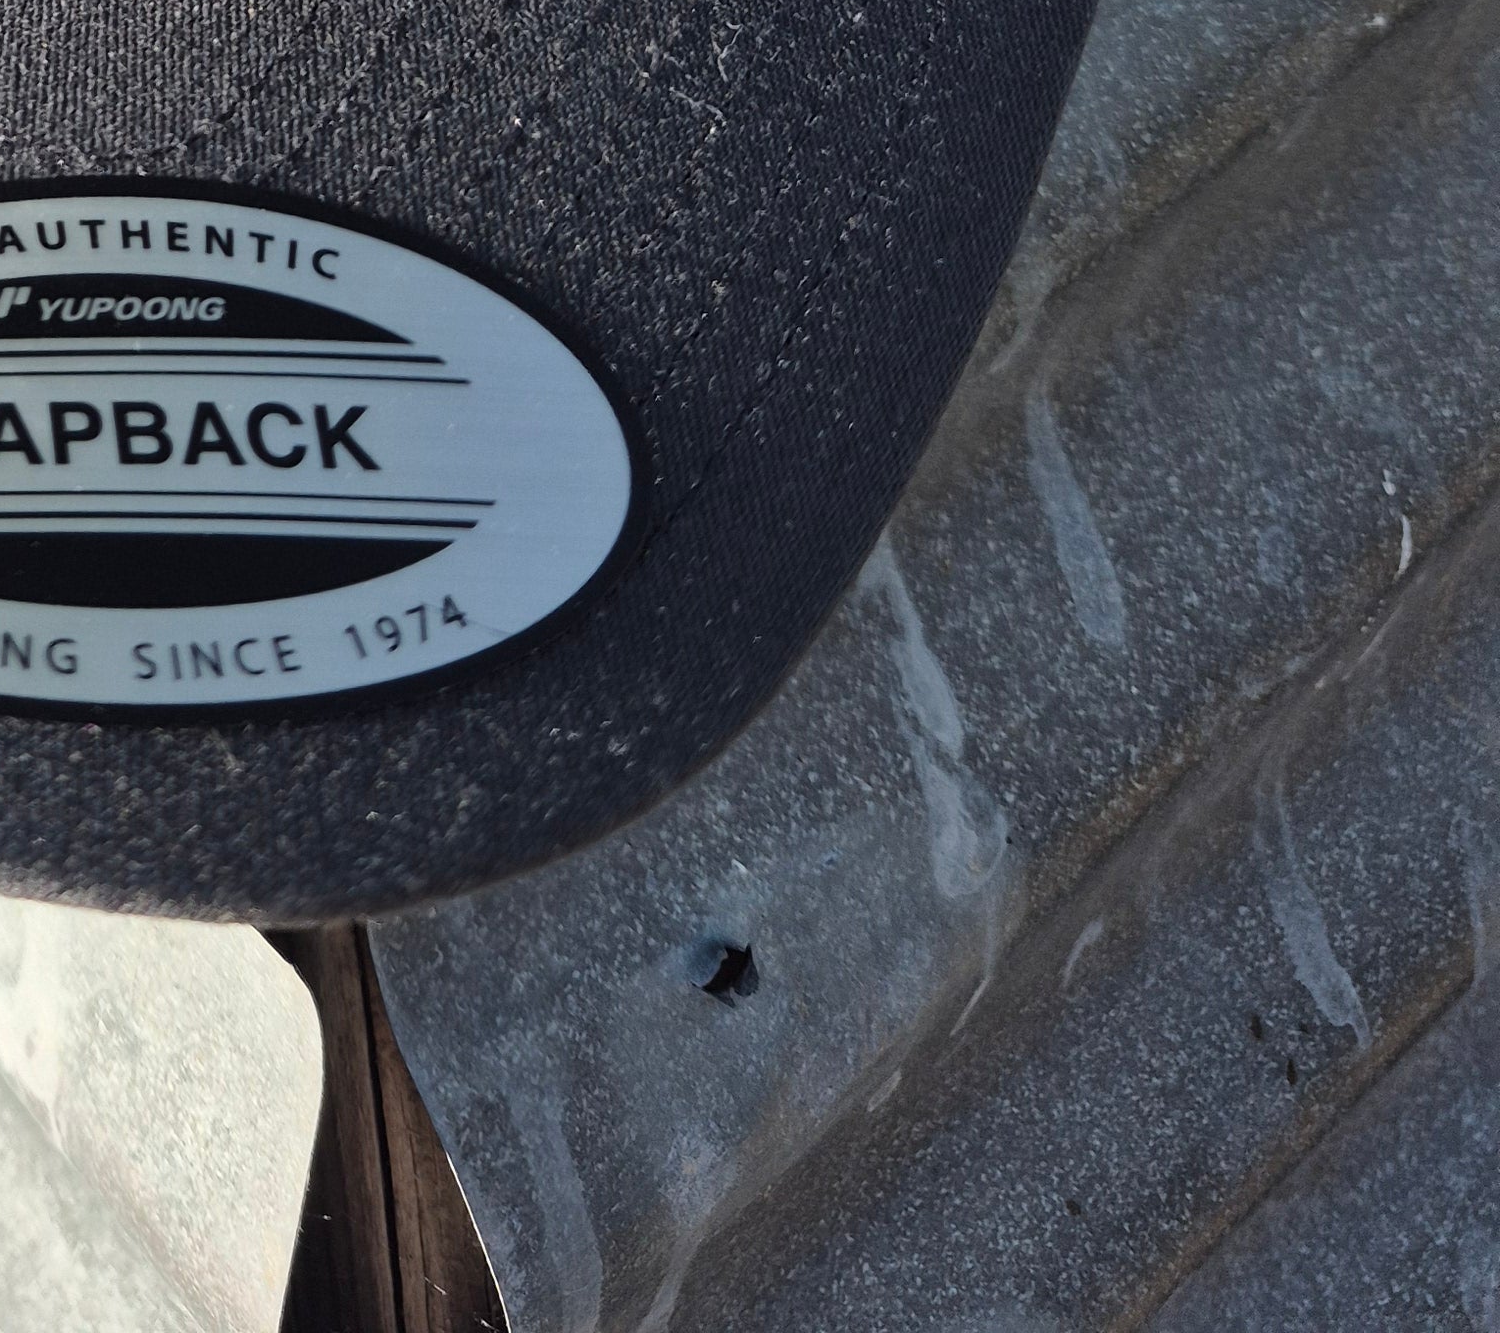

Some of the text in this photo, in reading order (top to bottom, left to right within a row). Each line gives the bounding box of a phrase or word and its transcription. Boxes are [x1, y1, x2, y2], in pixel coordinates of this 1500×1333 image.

[37, 294, 227, 323] YUPOONG
[133, 637, 302, 683] SINCE
[344, 593, 469, 661] 1974
